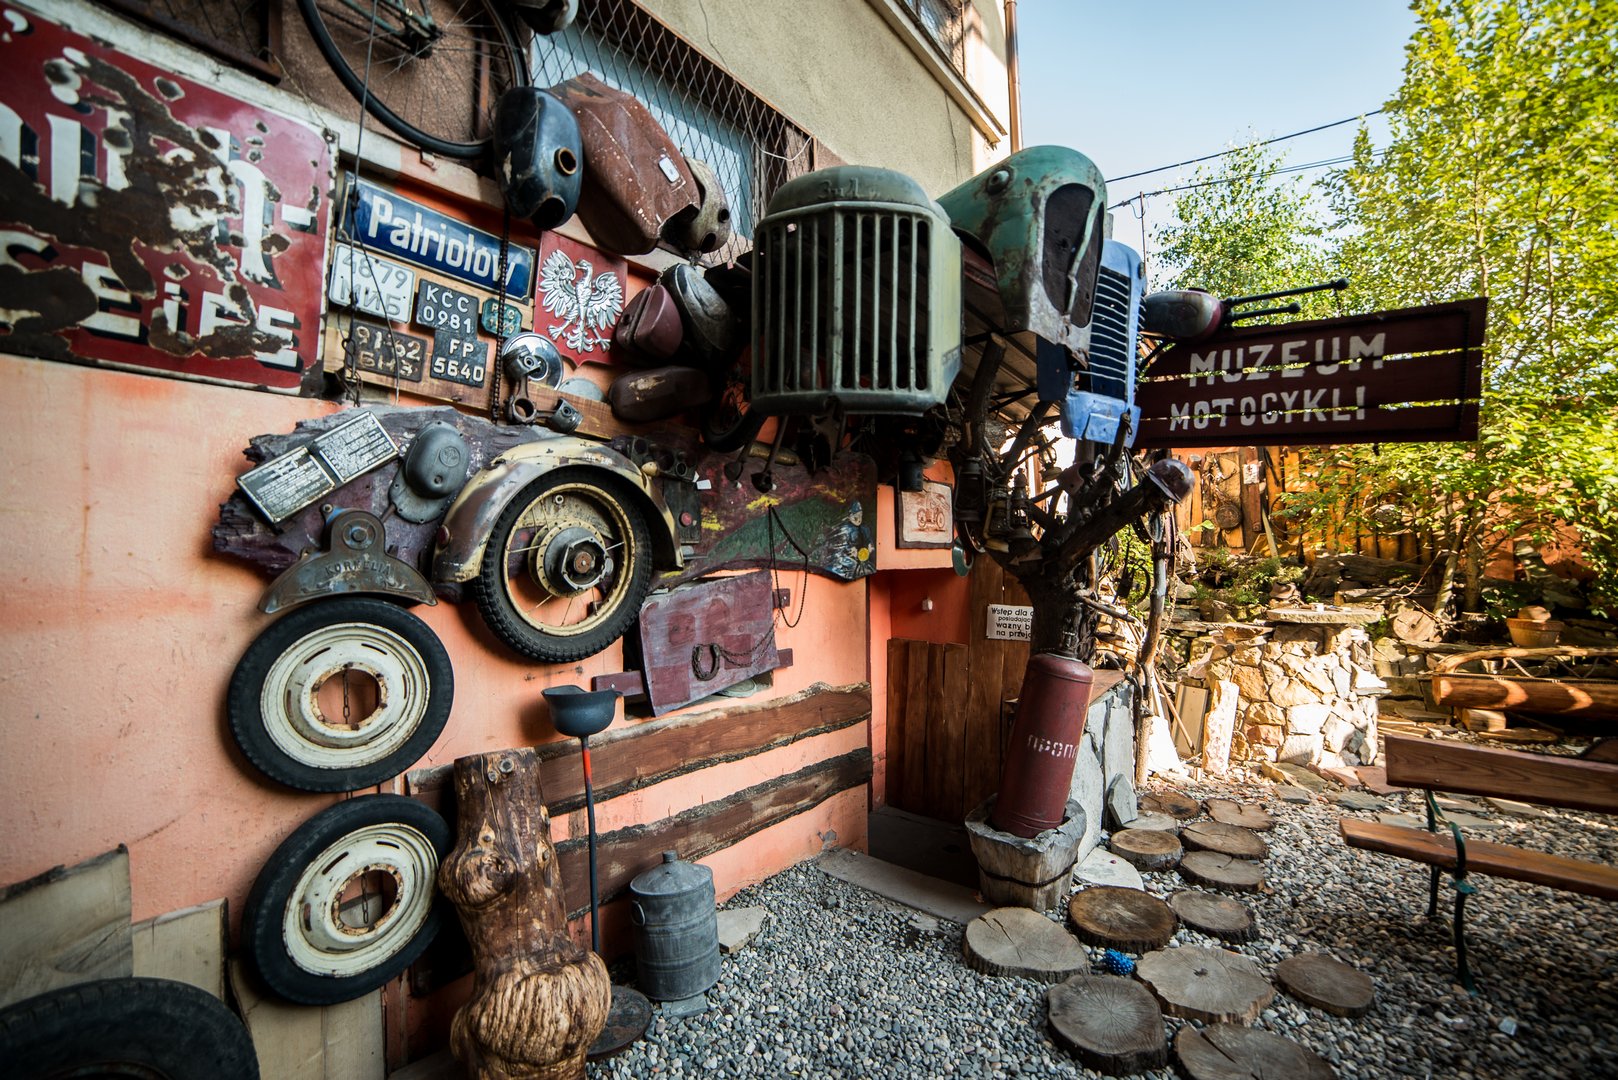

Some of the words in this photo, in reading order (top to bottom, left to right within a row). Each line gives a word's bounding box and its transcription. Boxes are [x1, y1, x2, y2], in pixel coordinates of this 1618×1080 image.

[367, 194, 516, 286] Patriotów
[426, 284, 470, 313] KCC
[422, 304, 472, 334] 0981
[449, 338, 475, 358] FP
[1188, 332, 1387, 388] MUZEUM
[433, 356, 485, 382] 5640
[1169, 385, 1366, 432] MOTOCYKLI
[324, 558, 392, 575] KORNELIA
[1014, 608, 1028, 616] dla
